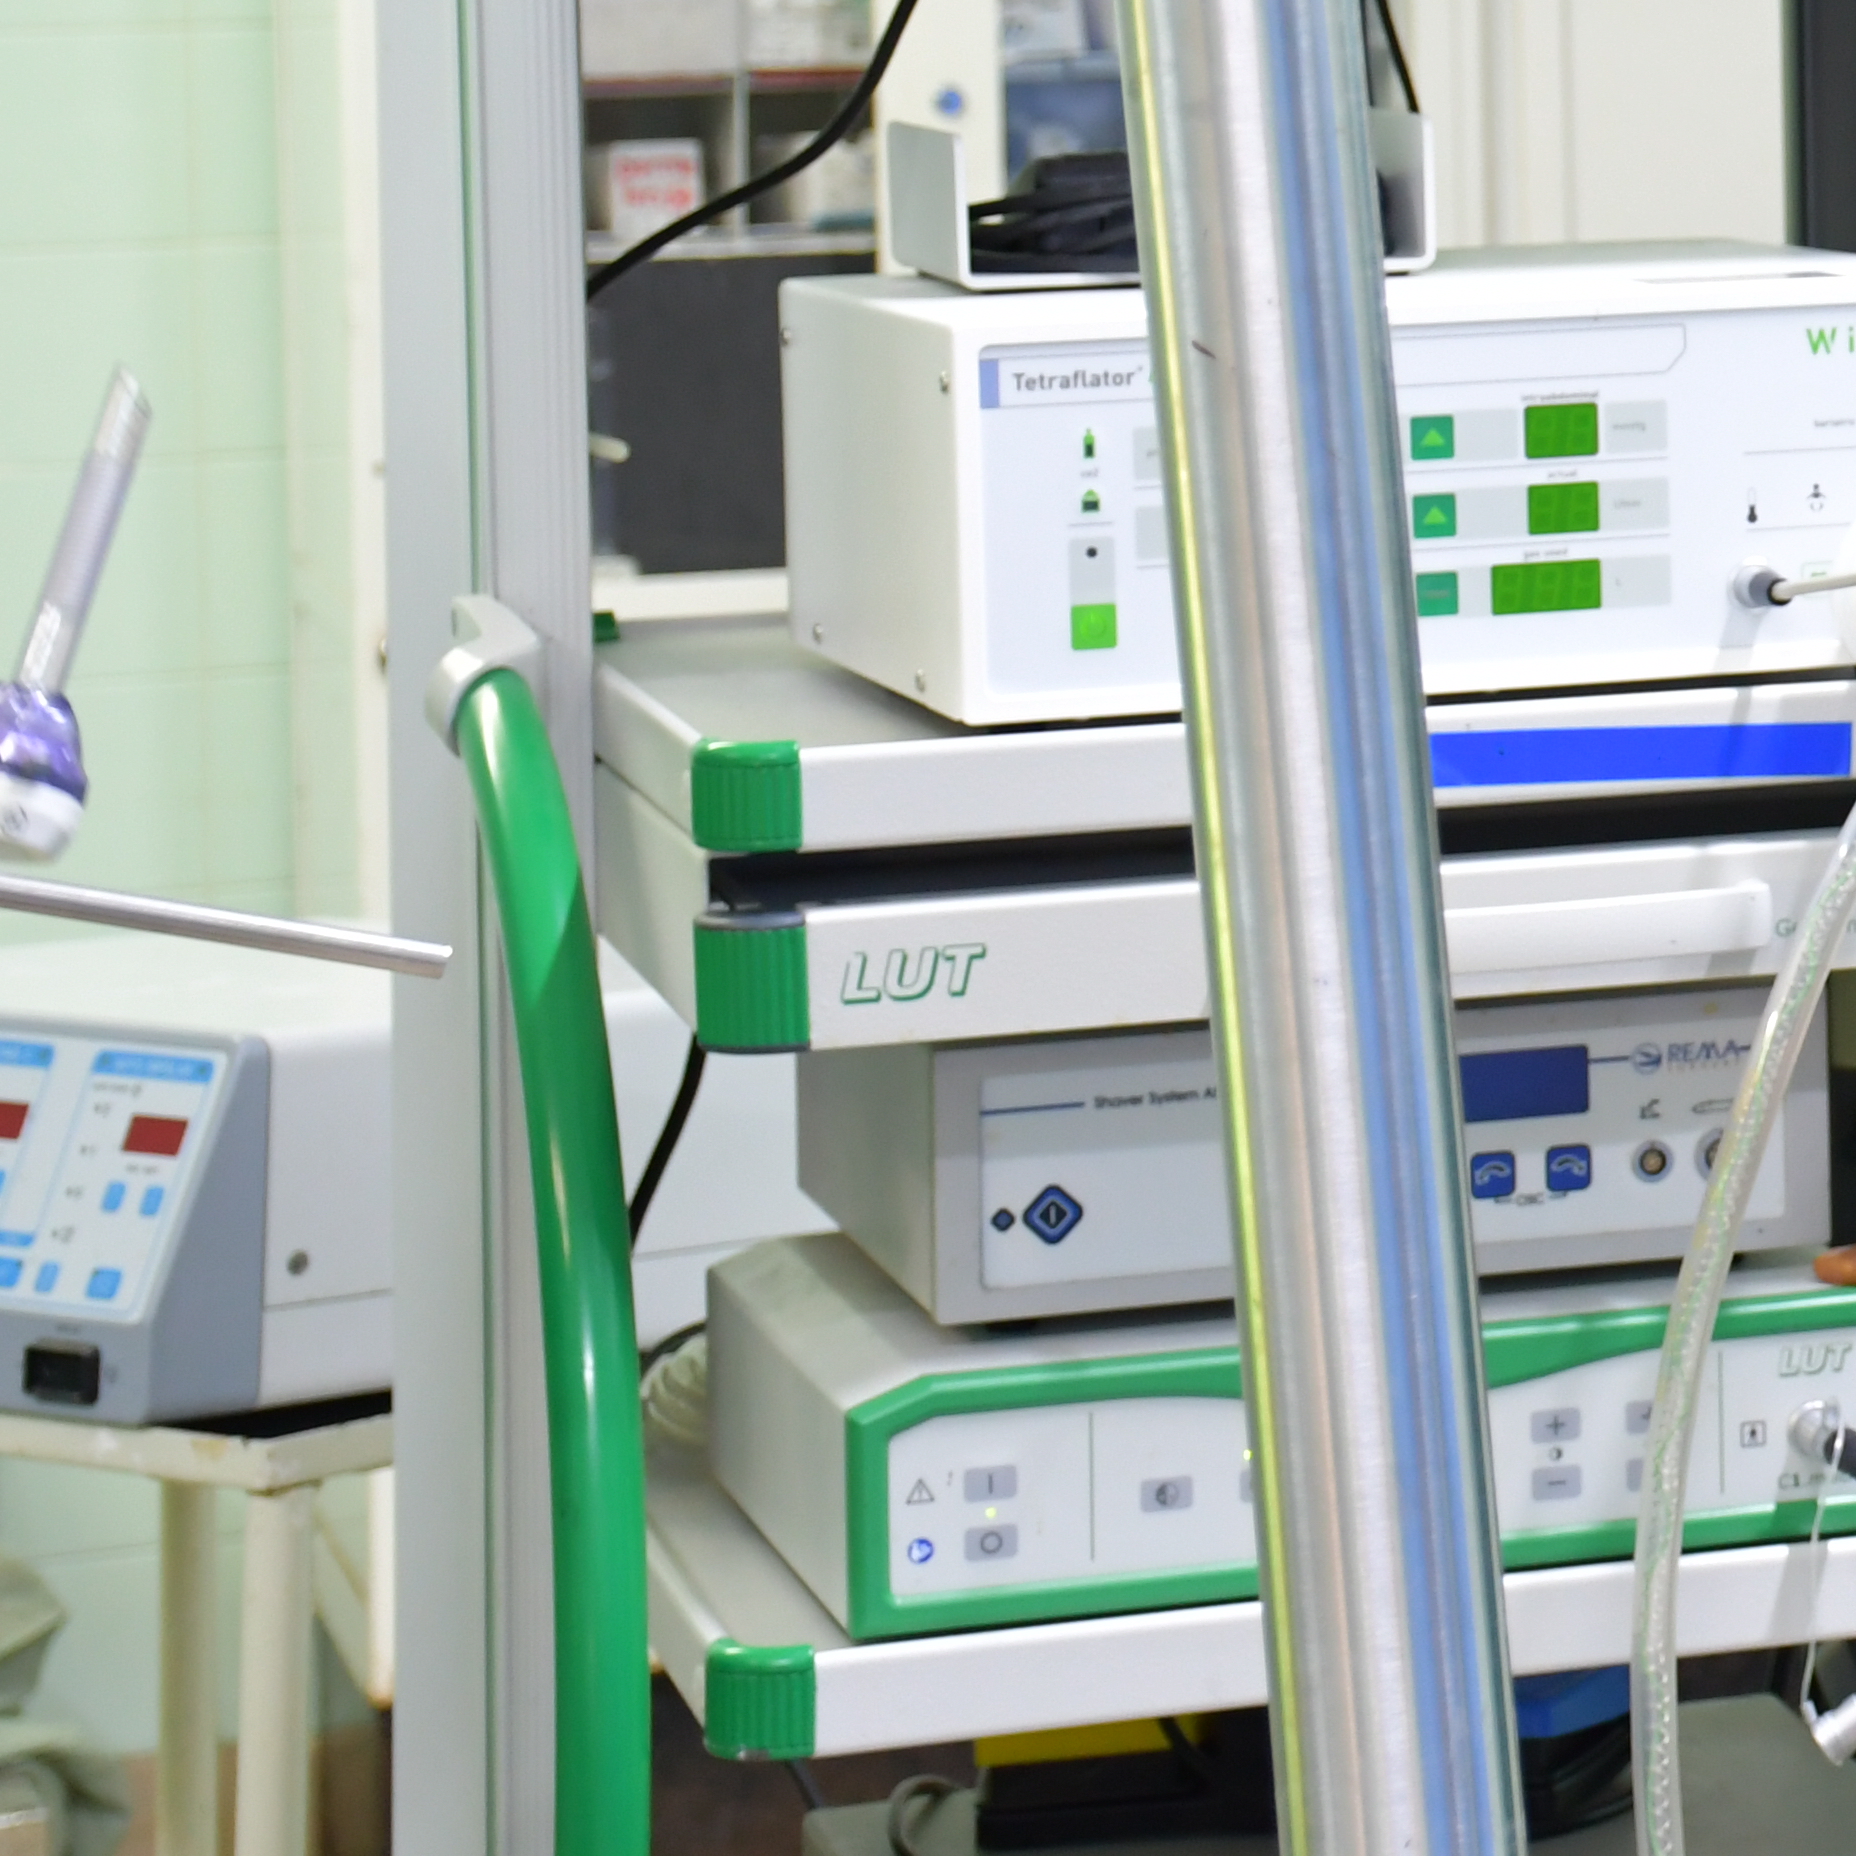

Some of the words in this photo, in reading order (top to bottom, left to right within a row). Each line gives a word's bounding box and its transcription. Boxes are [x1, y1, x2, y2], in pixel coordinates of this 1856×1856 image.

[1013, 370, 1134, 392] Tetraflator
[840, 943, 986, 1005] LUT
[1149, 1090, 1198, 1105] System
[1779, 1344, 1852, 1377] LUT
